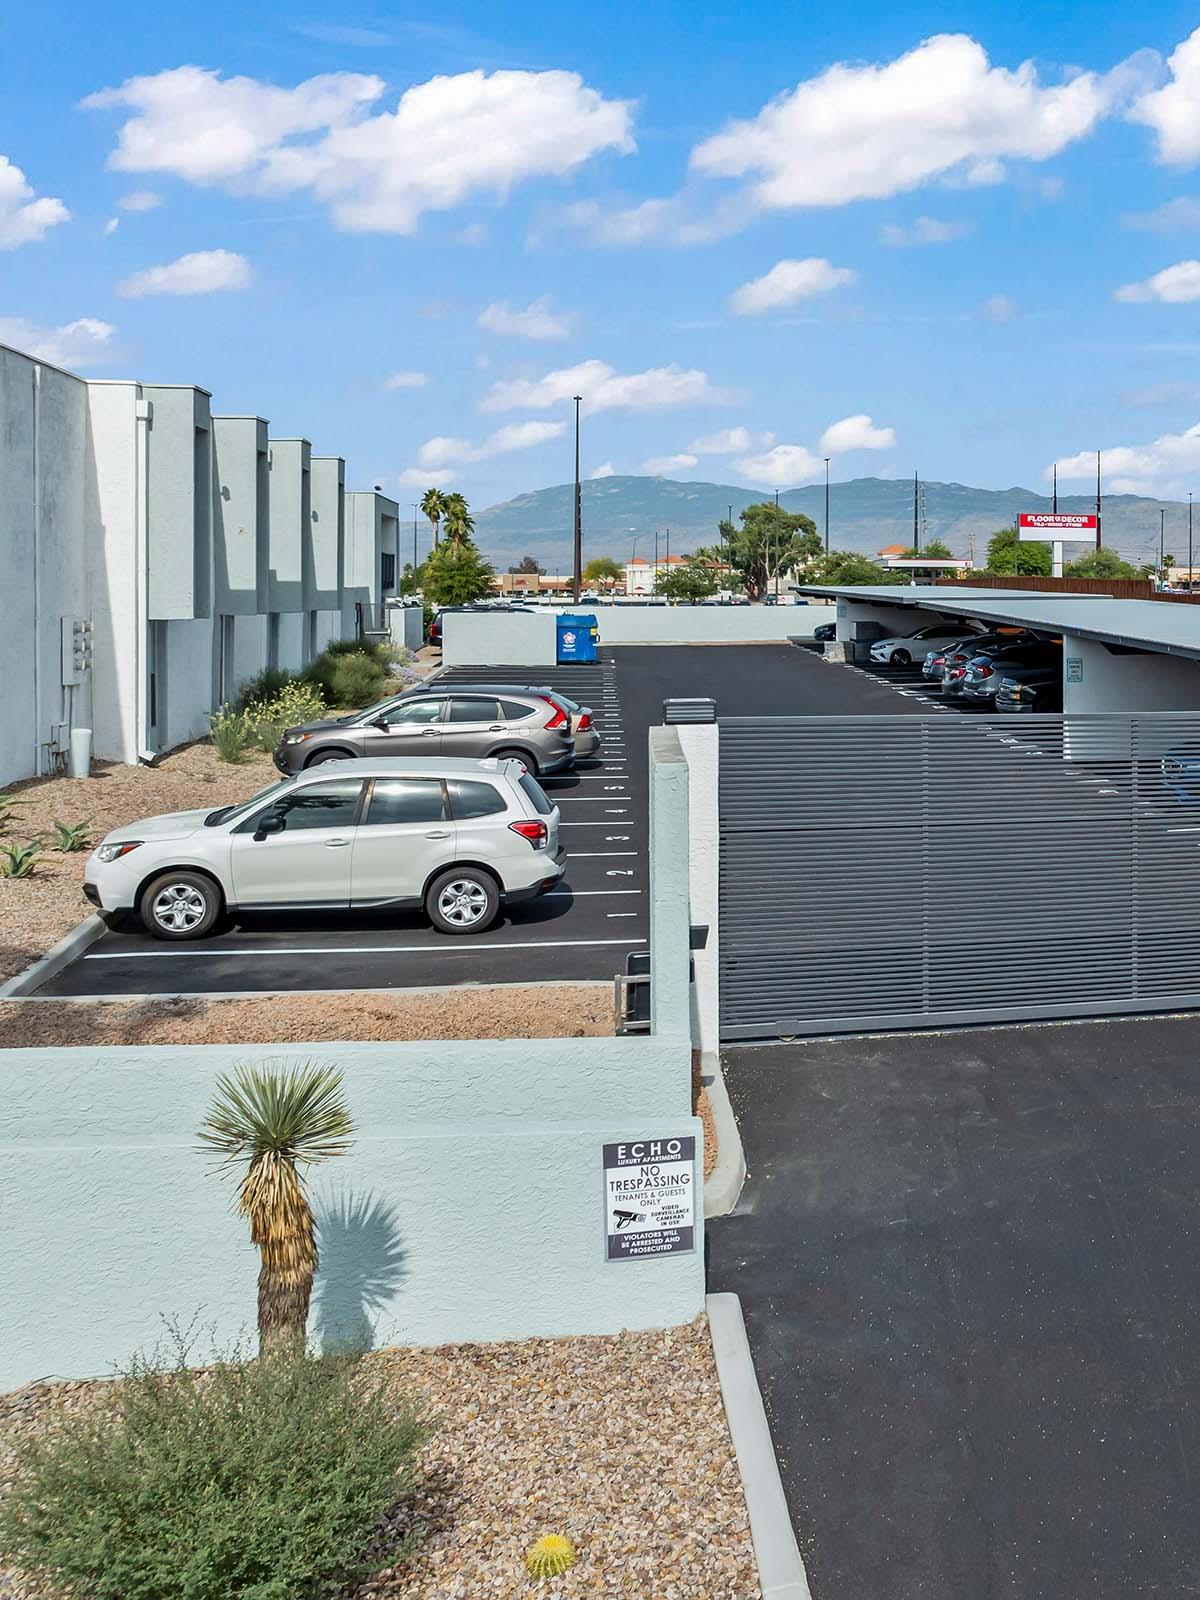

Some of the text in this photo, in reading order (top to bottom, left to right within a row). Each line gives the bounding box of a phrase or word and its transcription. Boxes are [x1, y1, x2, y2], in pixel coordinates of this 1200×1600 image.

[617, 1140, 681, 1159] ECHO
[618, 1154, 681, 1166] LUXURY APARTMENTS
[640, 1165, 660, 1177] NO
[609, 1173, 690, 1192] TRESPASSING
[615, 1188, 686, 1201] TENANTS & GUESTS
[640, 1199, 661, 1207] ONLY
[656, 1214, 684, 1222] CAMERAS
[624, 1231, 661, 1241] VIOLATORS
[631, 1238, 663, 1247] ARRESTED
[629, 1244, 673, 1254] PROSECUTED
